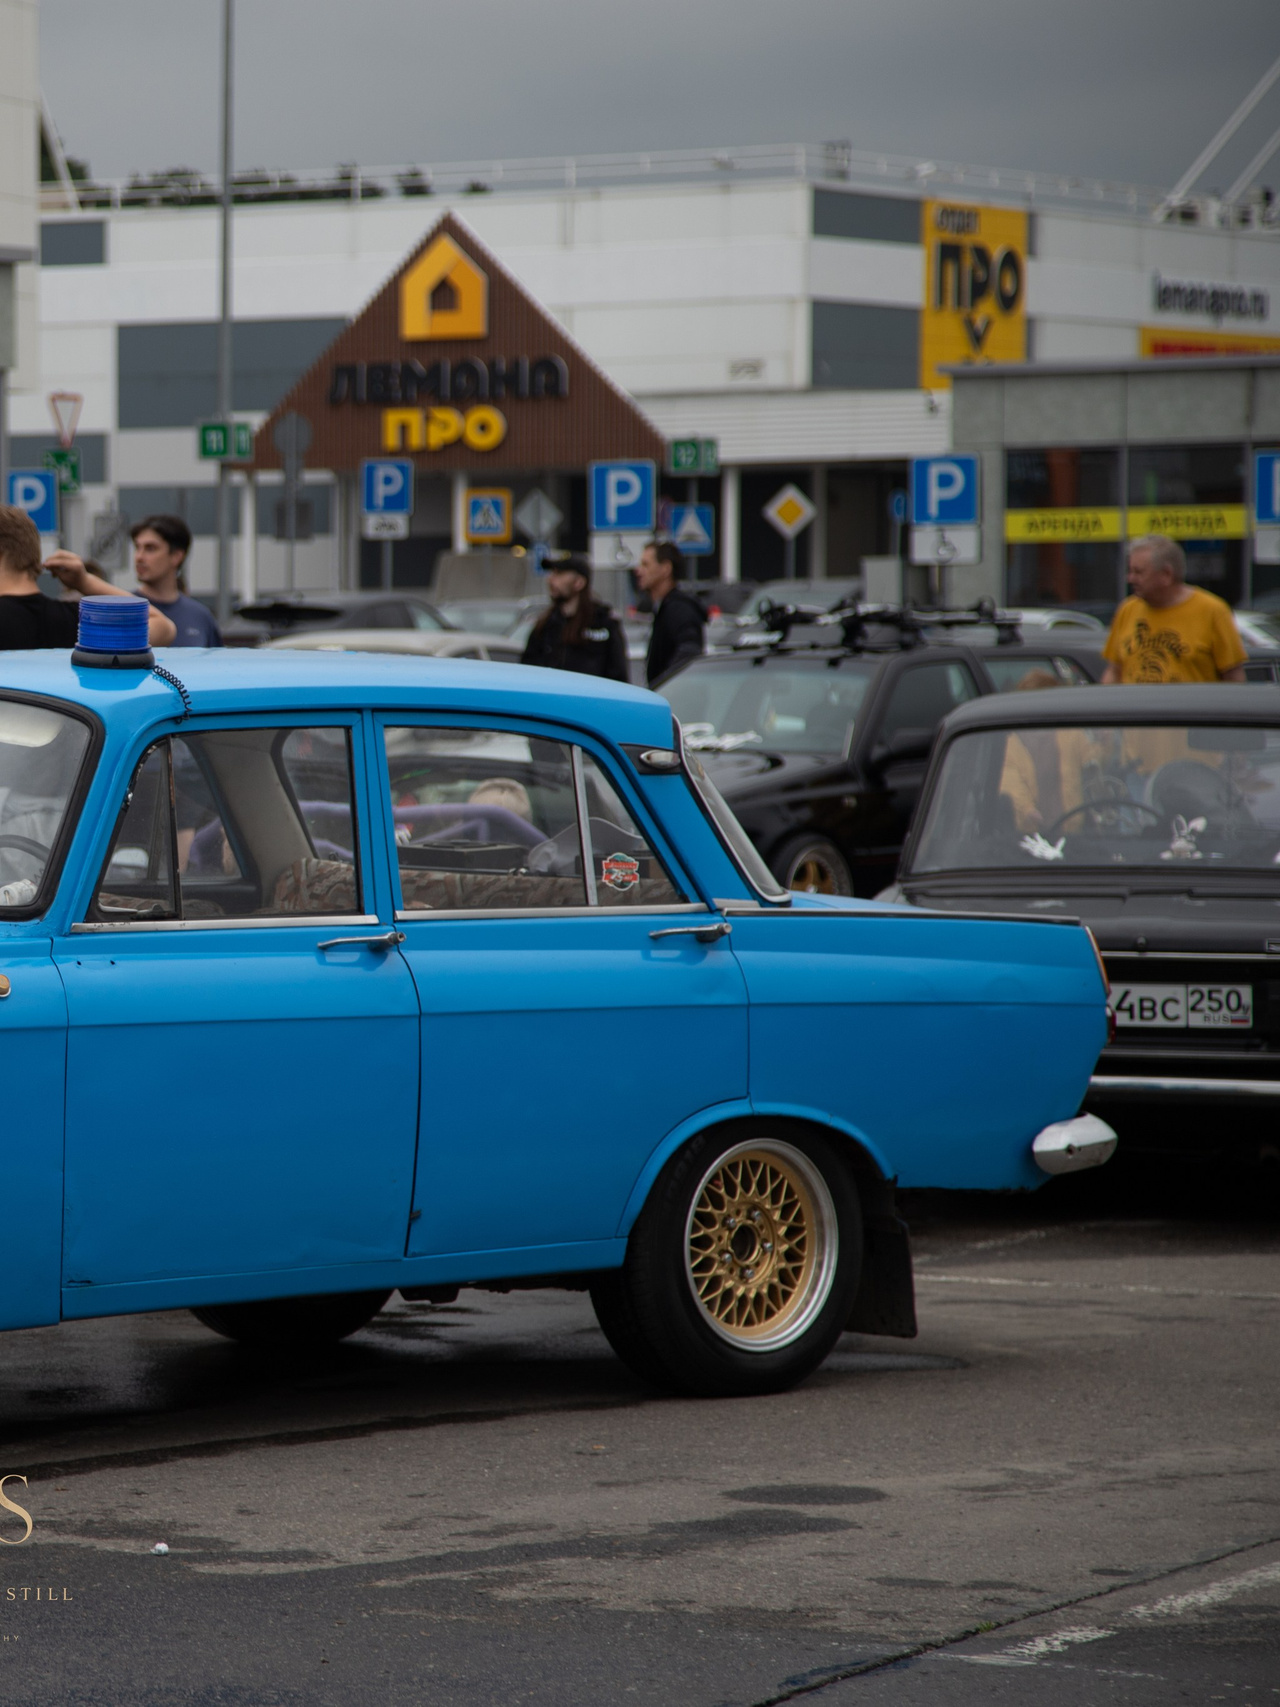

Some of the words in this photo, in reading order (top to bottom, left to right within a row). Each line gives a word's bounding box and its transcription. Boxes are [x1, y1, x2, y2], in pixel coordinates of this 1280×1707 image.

[934, 238, 1024, 315] ПРО
[381, 403, 508, 452] ПРО
[372, 464, 404, 509] P
[606, 468, 643, 524] P
[927, 461, 966, 519] P
[1190, 988, 1243, 1013] 250
[1203, 1014, 1230, 1025] RUS
